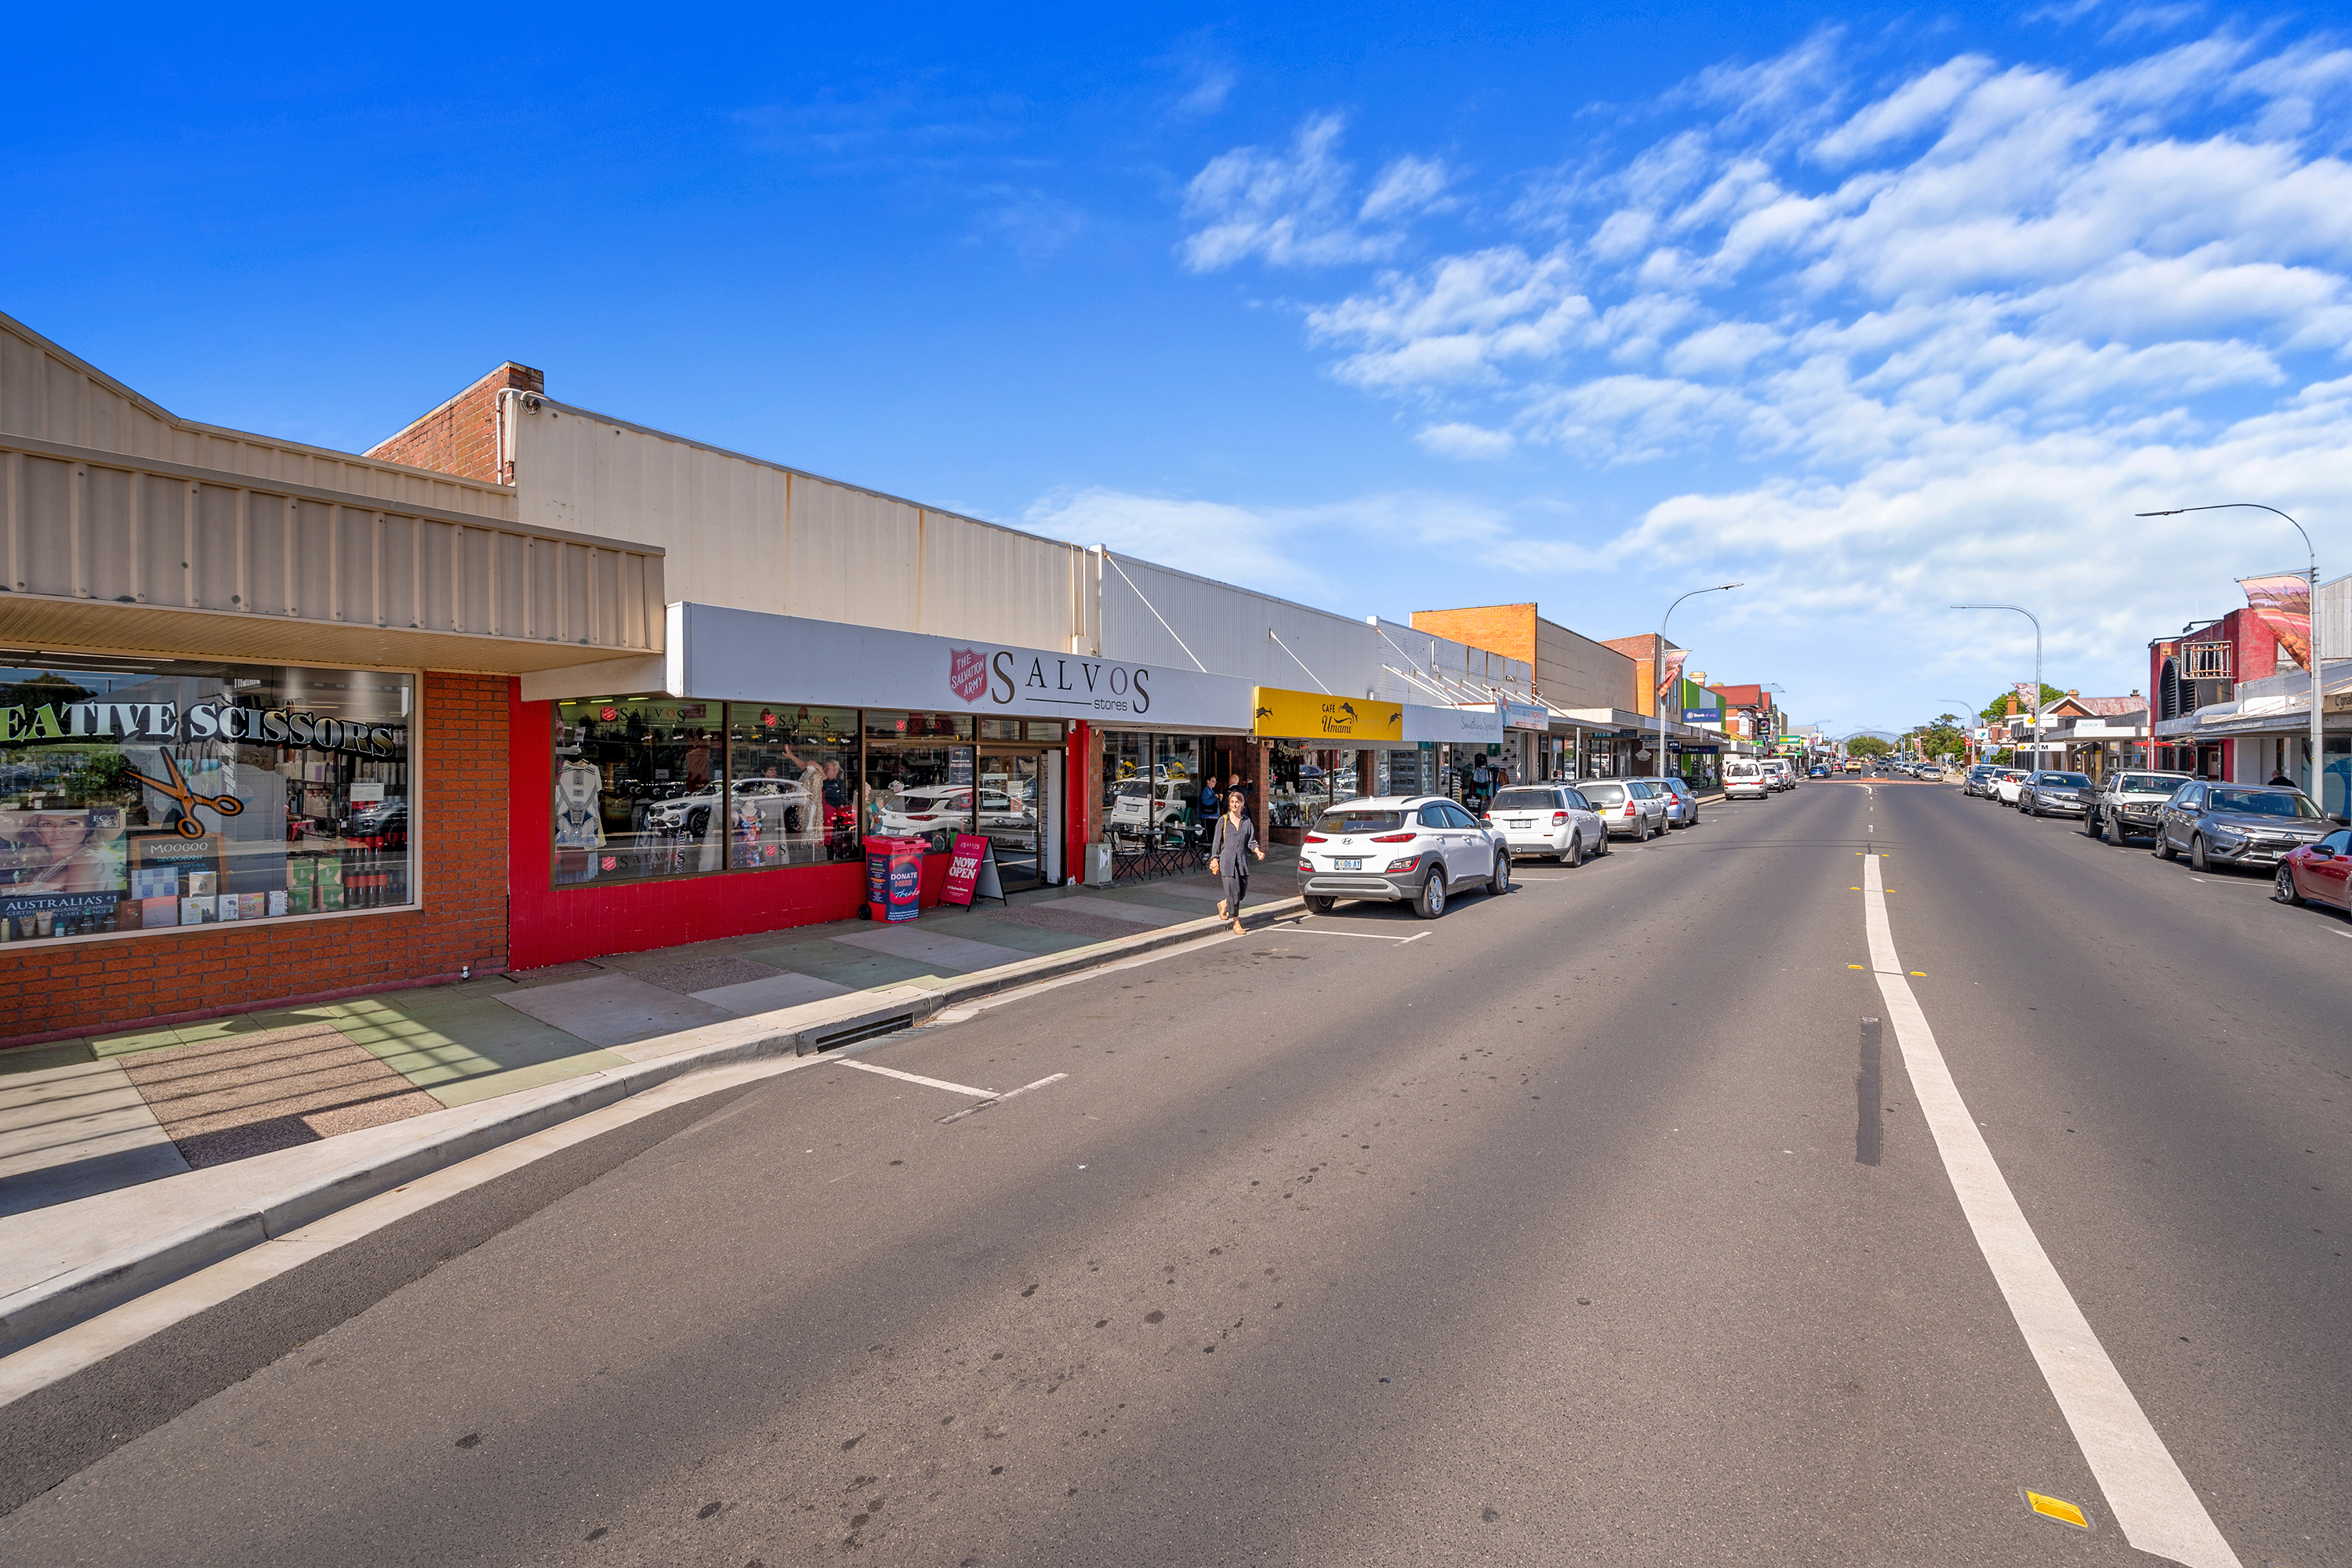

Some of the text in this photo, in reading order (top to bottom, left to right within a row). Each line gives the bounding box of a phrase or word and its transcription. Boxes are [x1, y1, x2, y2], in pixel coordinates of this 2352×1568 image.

[956, 654, 972, 670] THE
[951, 658, 984, 689] SALVATION
[964, 673, 983, 696] ARMY
[992, 651, 1150, 714] SALVOS
[1094, 698, 1127, 711] stores
[1322, 702, 1335, 713] CAFÉ
[190, 703, 394, 757] SCISSORS
[1322, 715, 1353, 734] Umami
[1461, 716, 1497, 739] Something Special
[151, 842, 208, 854] MOOGOO
[953, 856, 978, 869] NOW
[949, 866, 977, 880] OPEN
[895, 887, 920, 898] Thanks
[6, 895, 103, 910] AUSTRALIA'S
